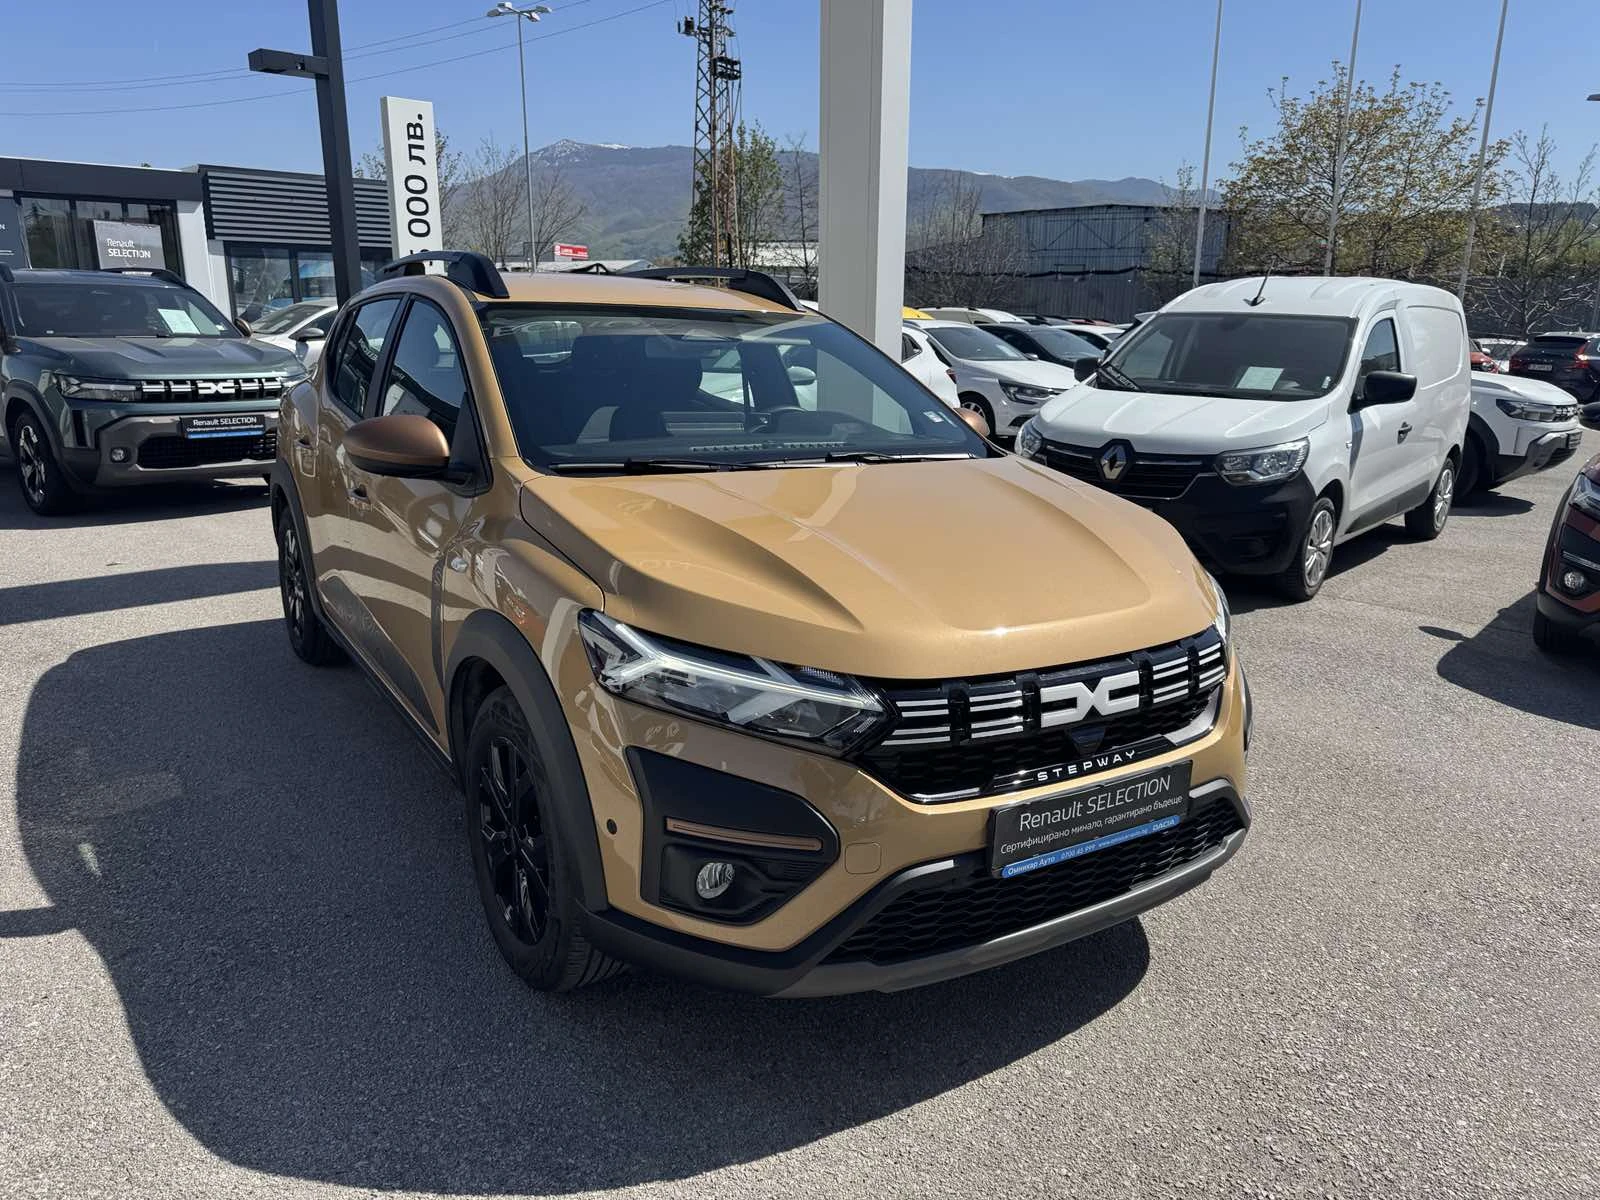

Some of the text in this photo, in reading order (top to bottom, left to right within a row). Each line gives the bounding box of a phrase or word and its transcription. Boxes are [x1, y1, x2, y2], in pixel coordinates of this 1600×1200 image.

[106, 238, 134, 248] Renault
[108, 248, 151, 258] SELECTION
[193, 416, 257, 426] Renault SELECTION
[1037, 749, 1136, 782] STEPWAY
[1019, 775, 1171, 831] Renault SELECTION
[1000, 796, 1183, 854] Сертифицирано минало, гарантирано бъдеще
